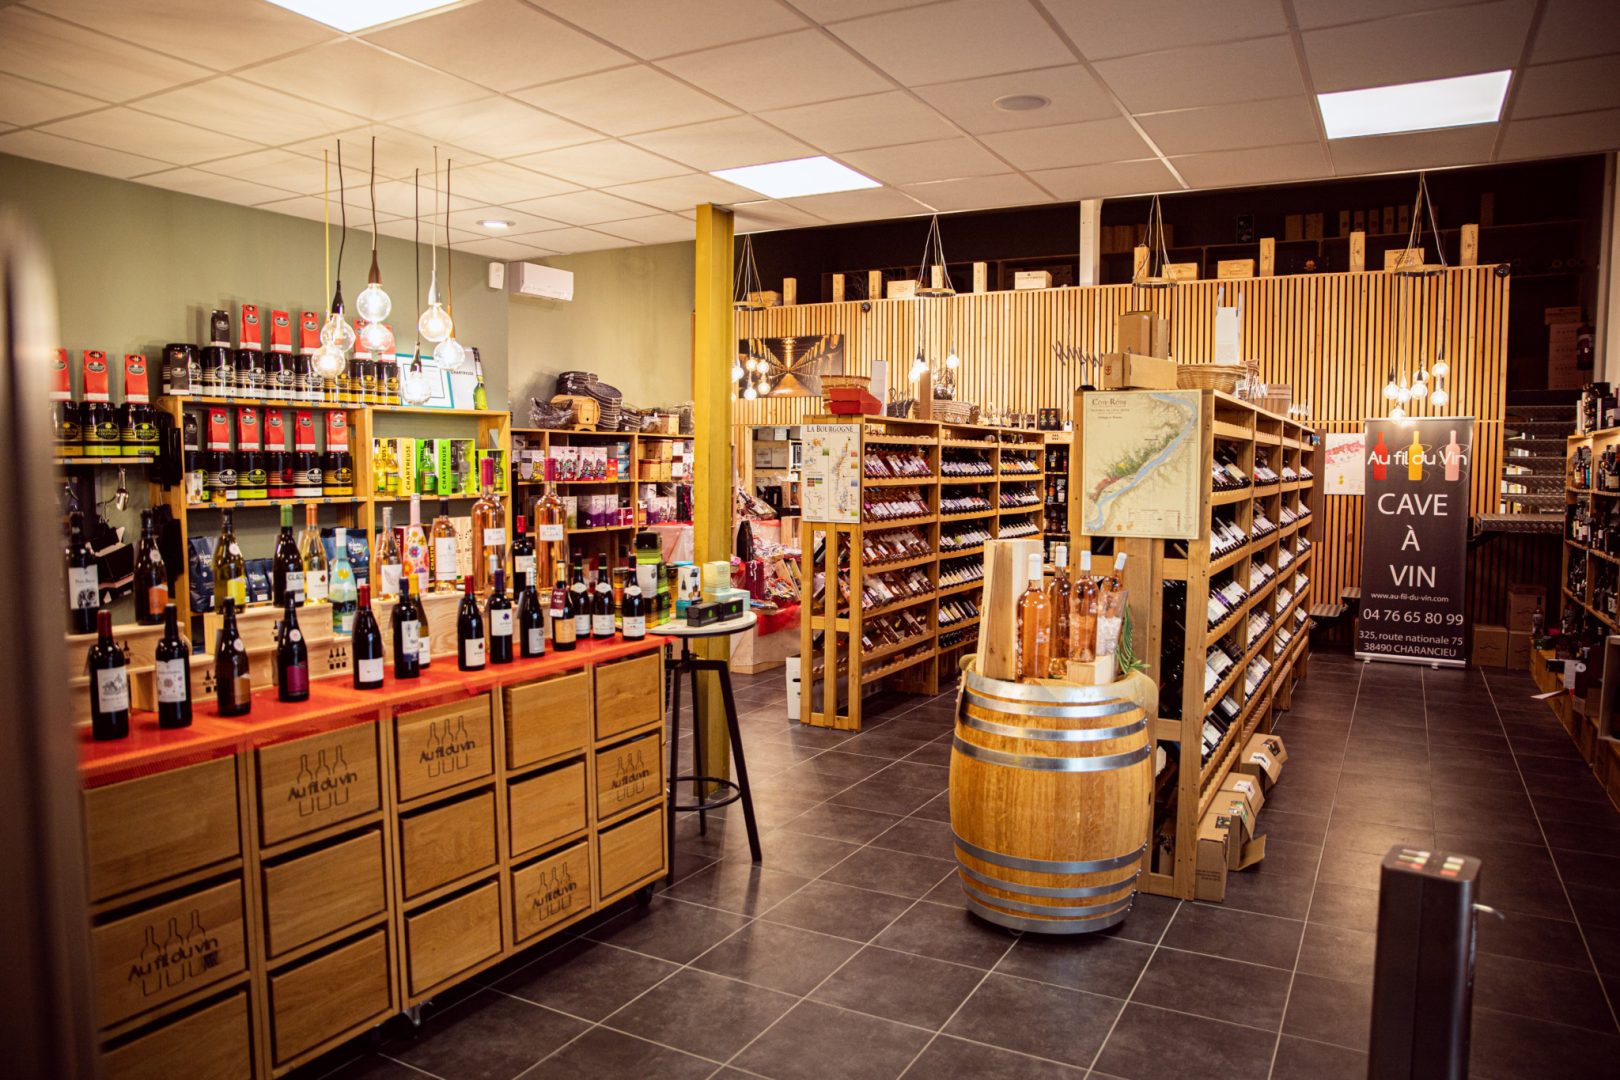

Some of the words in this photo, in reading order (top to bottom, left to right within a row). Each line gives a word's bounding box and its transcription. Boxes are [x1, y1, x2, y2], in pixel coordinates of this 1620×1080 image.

[816, 424, 854, 433] BOURGOGNE
[1367, 450, 1391, 465] Au
[1393, 450, 1409, 466] fil
[1411, 450, 1436, 466] du
[1439, 450, 1468, 466] Vin
[1377, 492, 1448, 516] CAVE
[1400, 524, 1421, 552] À
[1389, 564, 1436, 588] VIN
[1370, 592, 1449, 603] www.au-fil-du-vin.com
[1363, 608, 1380, 621] 04
[1383, 609, 1400, 622] 76
[1403, 611, 1421, 623] 65
[1425, 612, 1443, 625] 80
[1446, 613, 1464, 626] 99
[1359, 630, 1378, 640] 325,
[1379, 632, 1404, 642] route
[1405, 634, 1449, 645] nationale
[1451, 636, 1463, 646] 75
[1364, 642, 1392, 652] 38490
[1393, 644, 1456, 657] CHARANCIEU
[419, 751, 434, 764] Au
[288, 787, 306, 801] Au
[128, 962, 151, 982] Au
